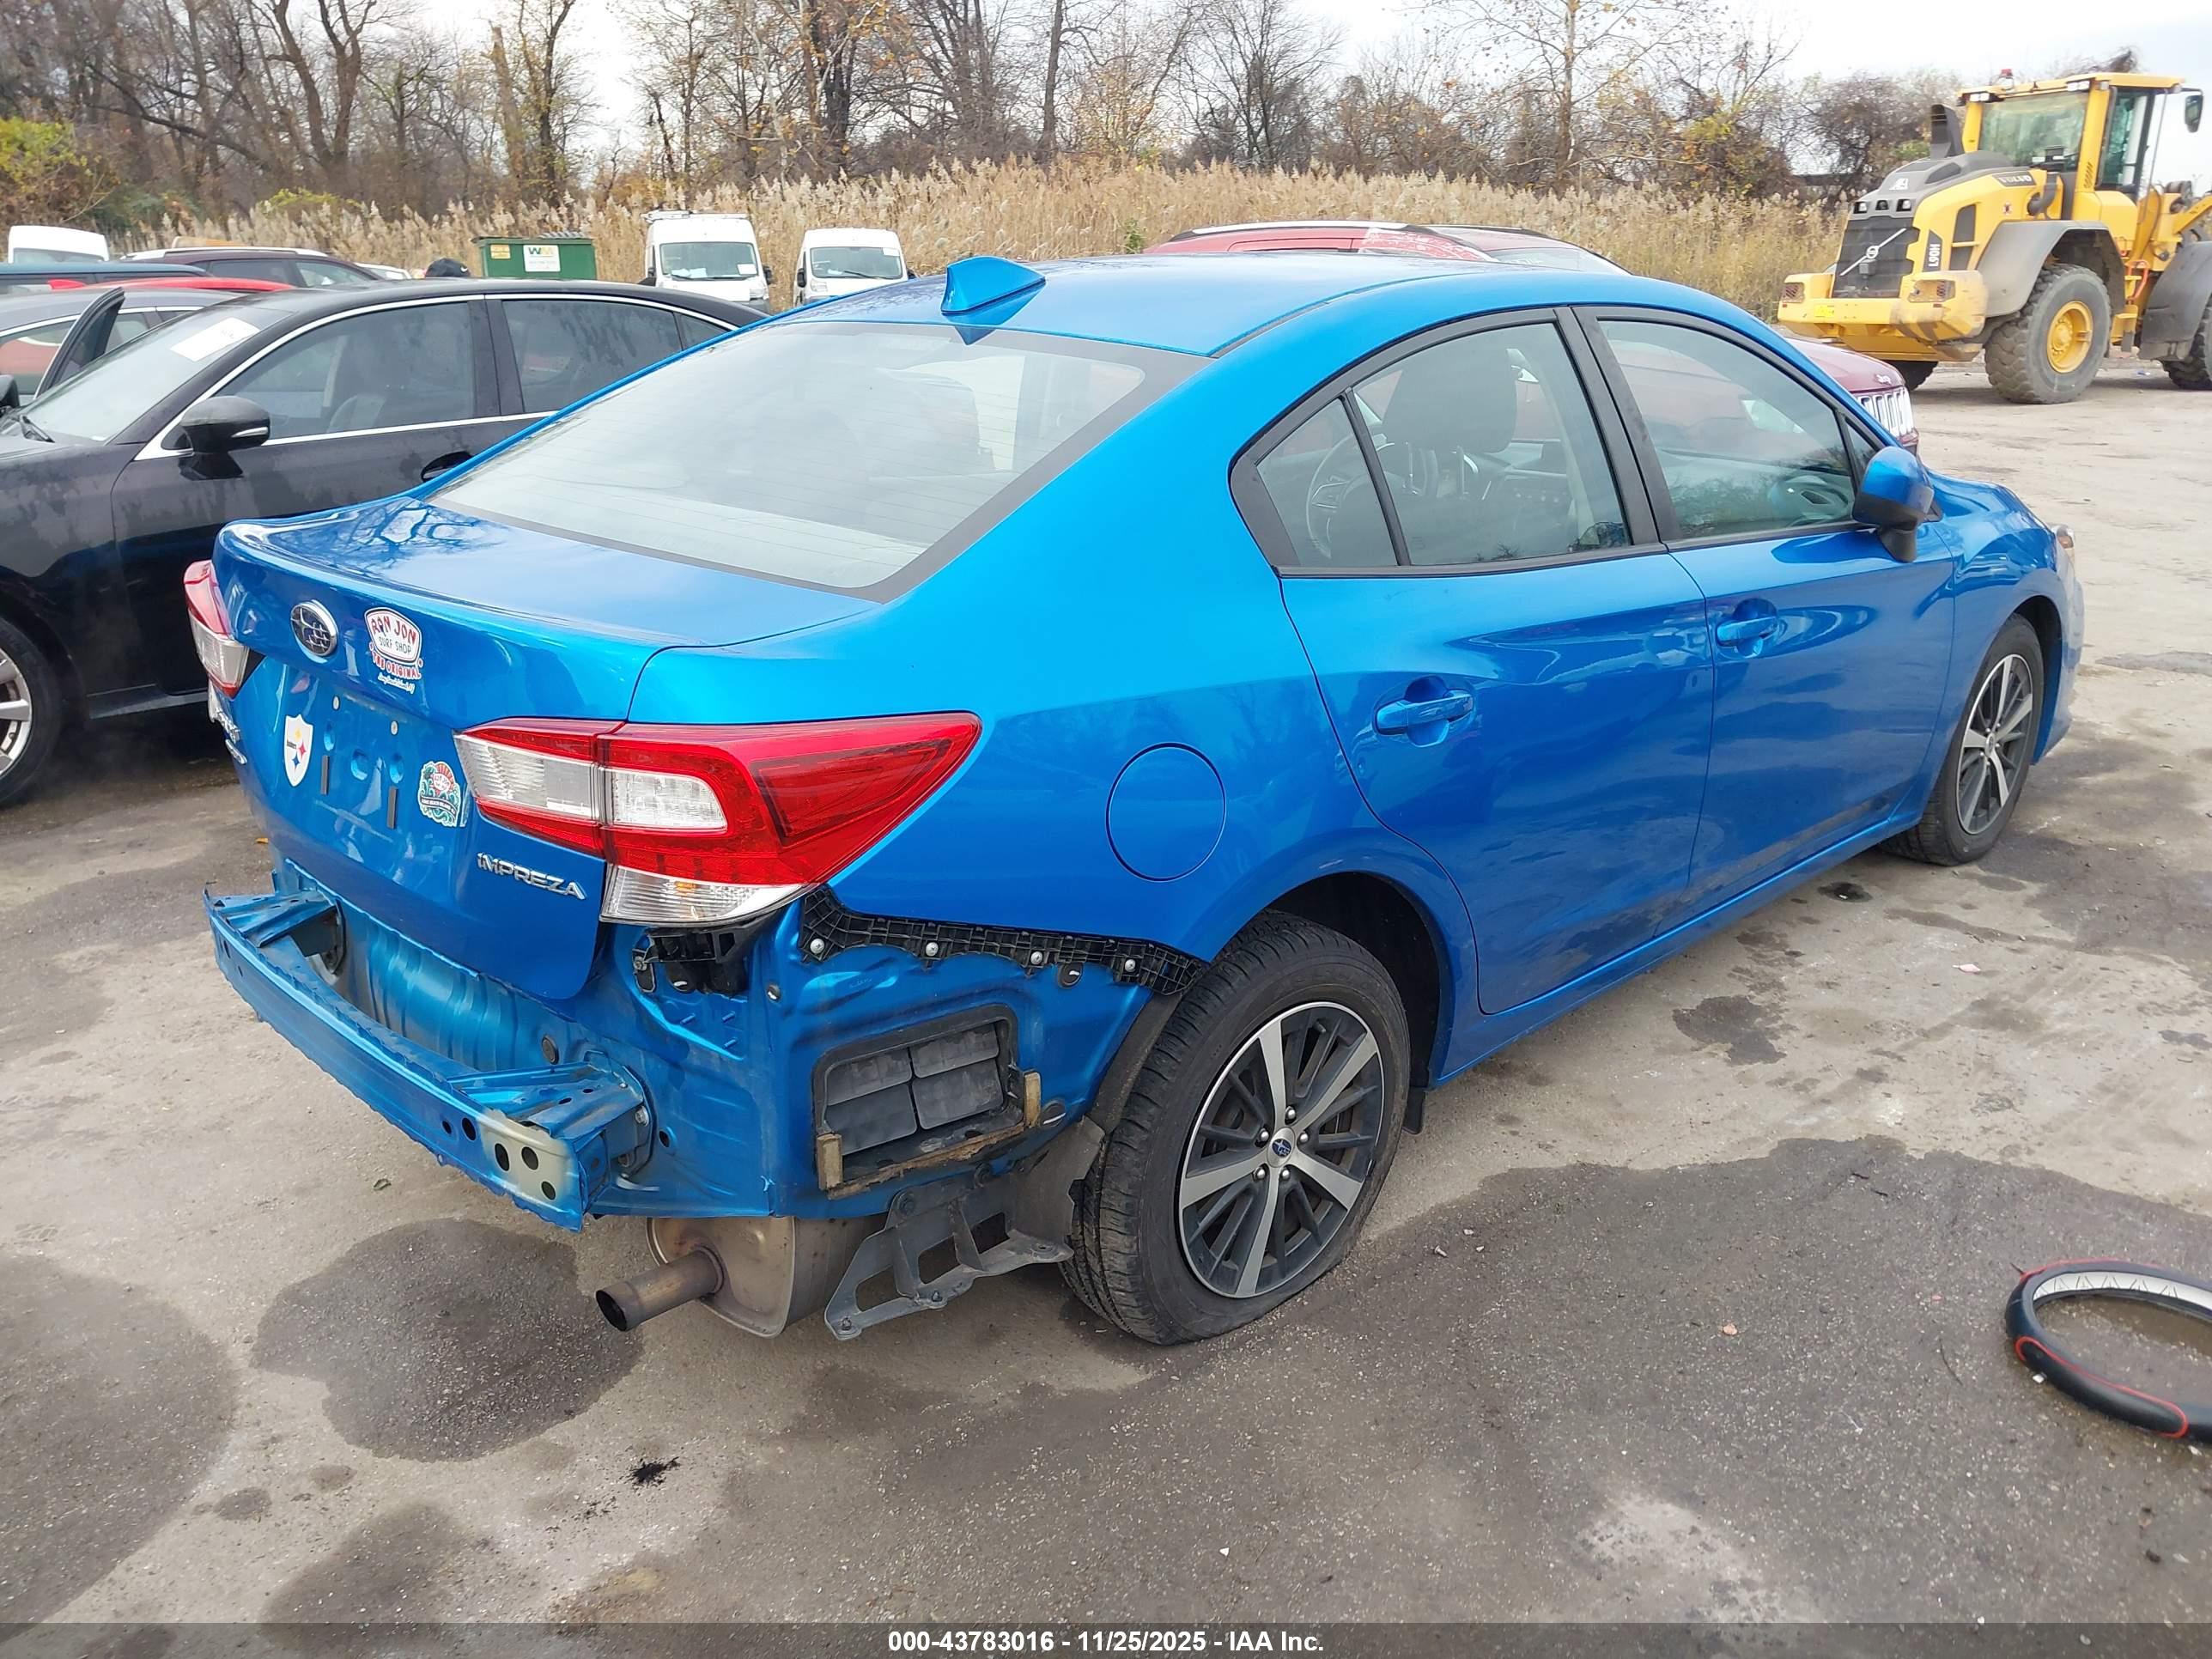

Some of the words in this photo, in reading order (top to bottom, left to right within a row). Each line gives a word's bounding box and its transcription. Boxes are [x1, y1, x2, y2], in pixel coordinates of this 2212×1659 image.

[1929, 244, 1941, 267] L90H
[371, 616, 392, 636] RON
[394, 620, 417, 645] JON
[379, 636, 392, 649] SURF
[395, 641, 412, 655] SHOP
[386, 661, 422, 679] ORIGINAL
[477, 852, 586, 900] IMPREZA
